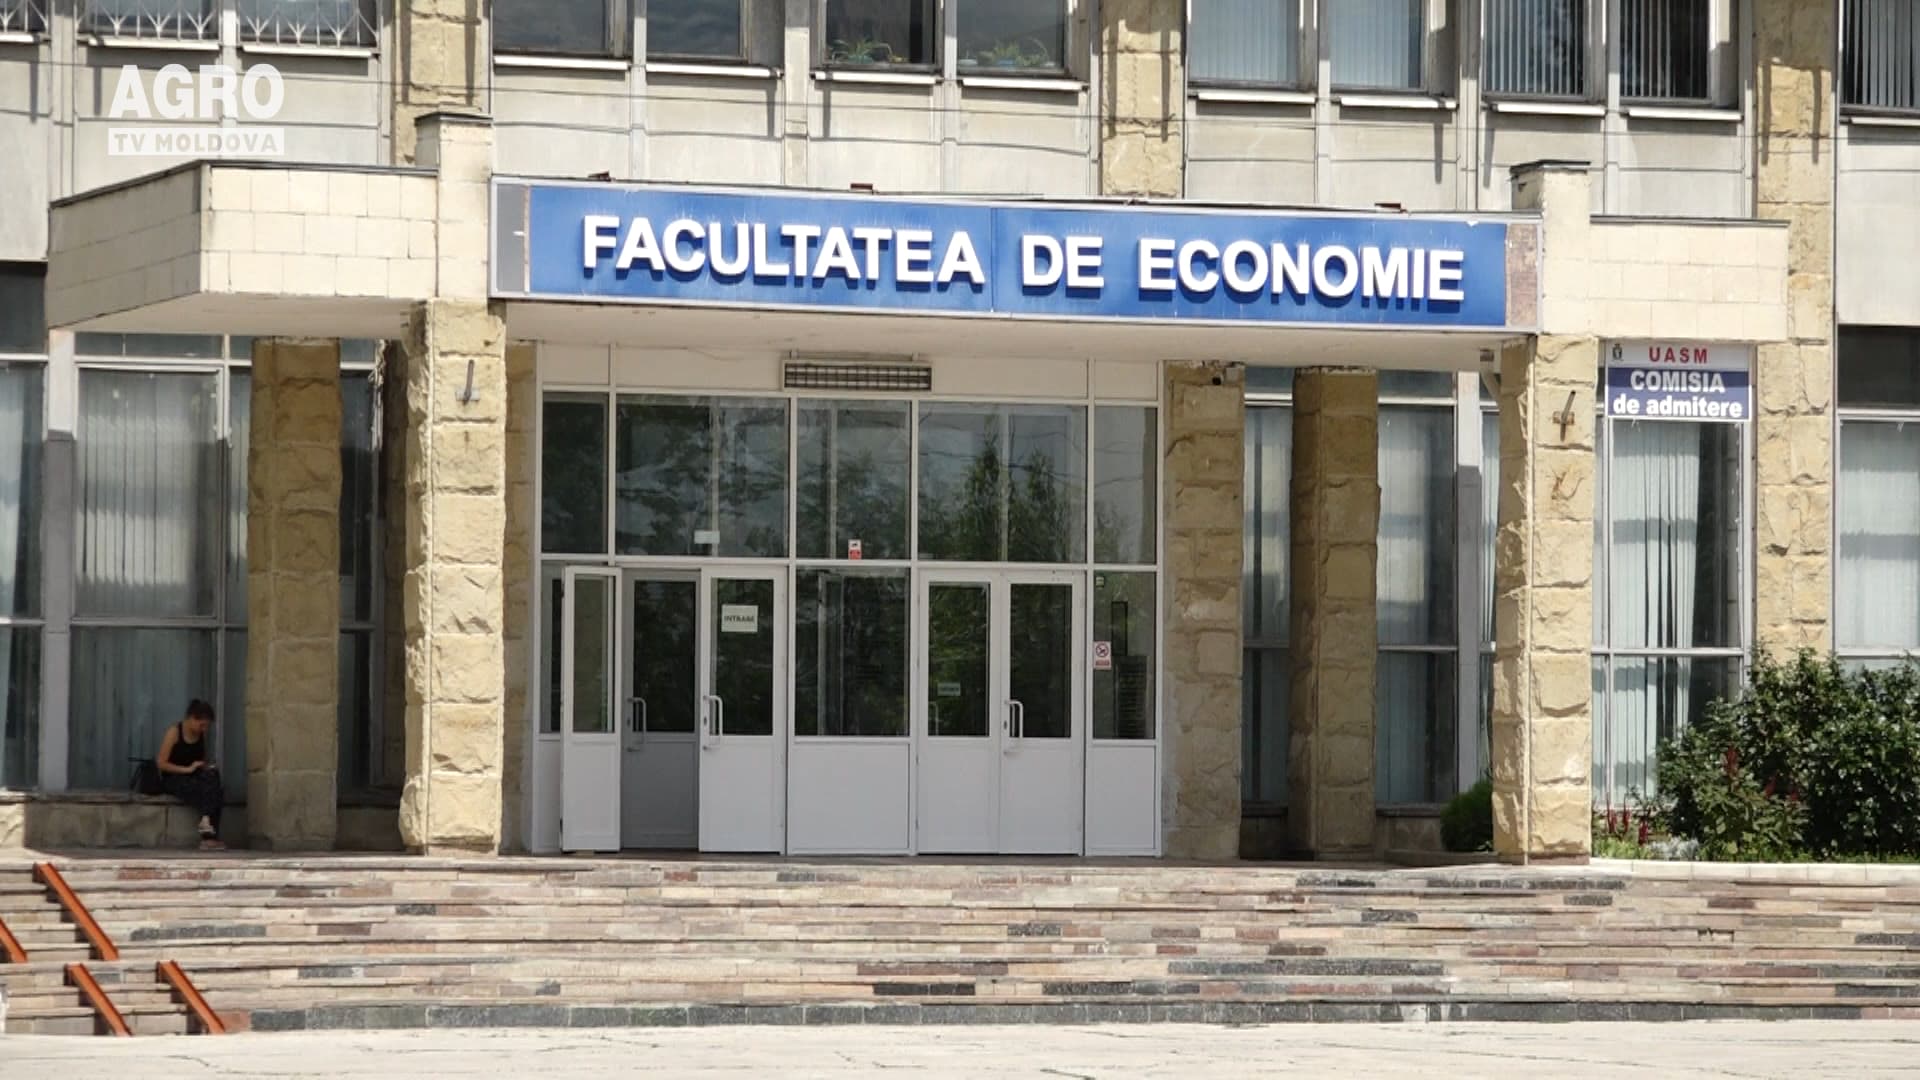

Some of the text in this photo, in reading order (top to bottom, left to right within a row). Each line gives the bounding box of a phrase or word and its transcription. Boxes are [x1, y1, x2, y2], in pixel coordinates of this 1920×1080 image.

[583, 215, 1465, 300] FACULTATEA DE ECONOMIE
[1649, 347, 1708, 363] UASM
[1630, 370, 1726, 393] COMISIA
[1613, 393, 1743, 418] de admitere
